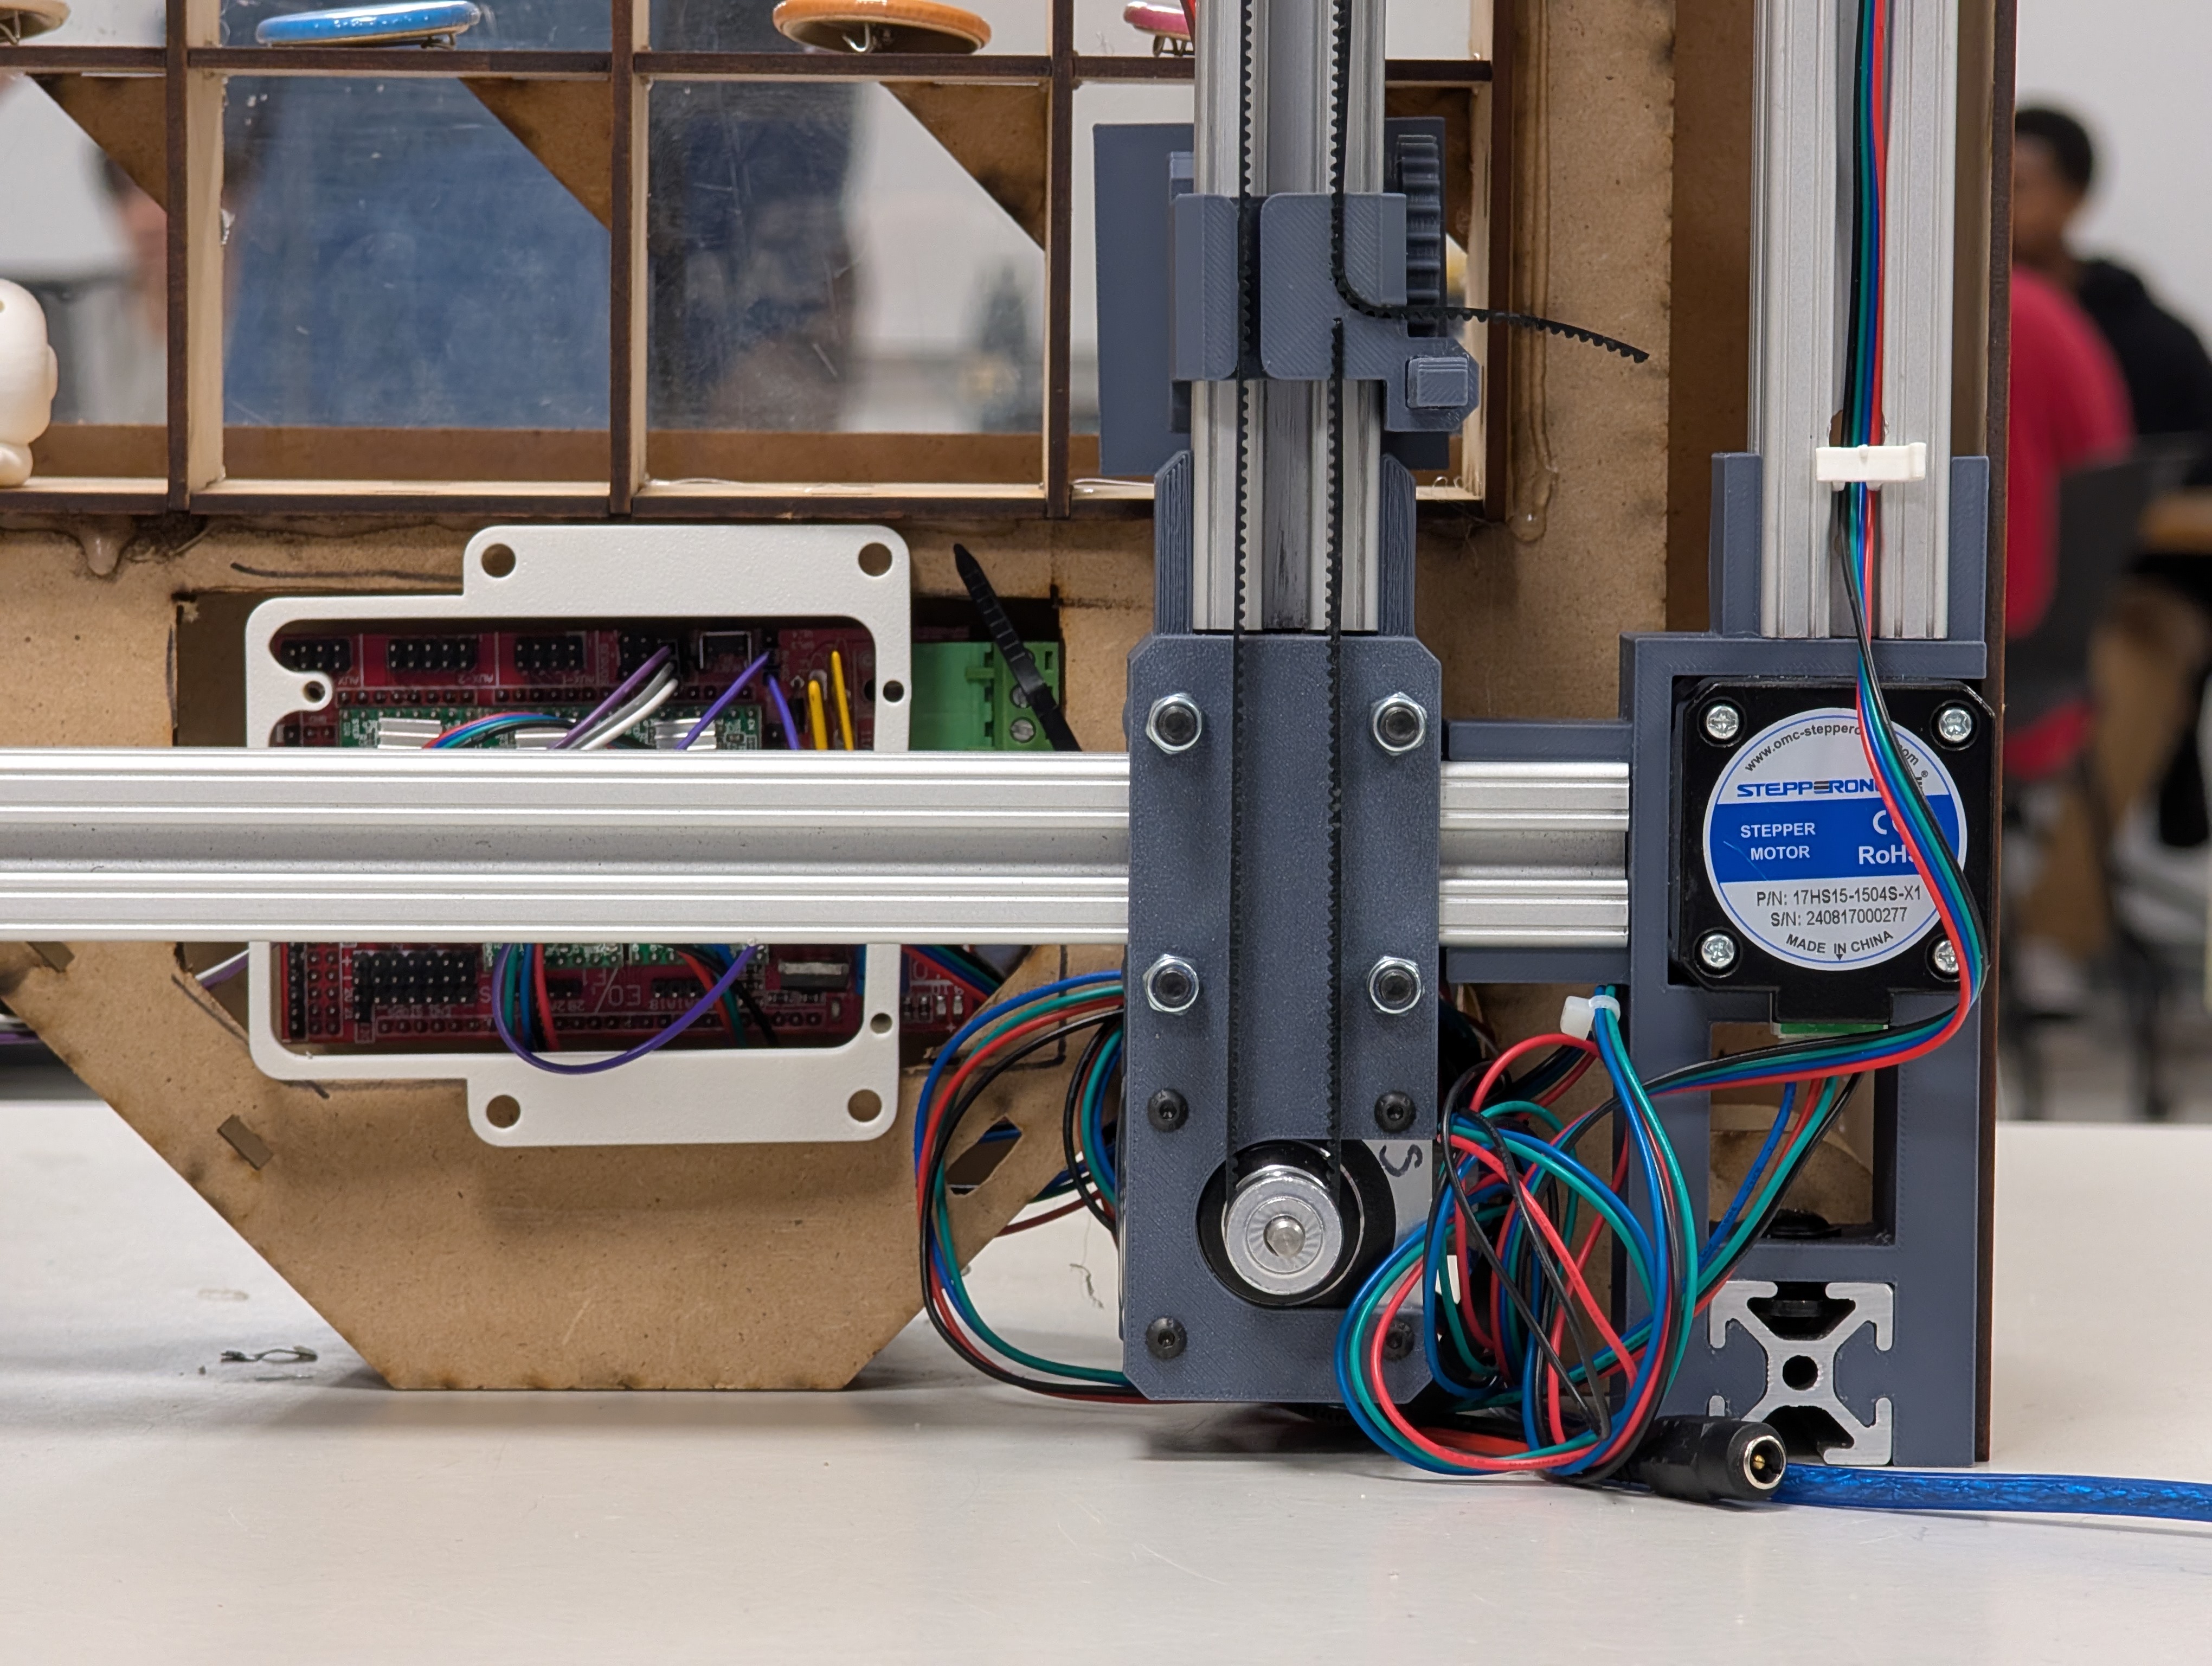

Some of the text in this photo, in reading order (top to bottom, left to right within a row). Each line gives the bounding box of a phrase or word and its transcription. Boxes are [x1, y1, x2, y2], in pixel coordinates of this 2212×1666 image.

[1740, 822, 1816, 838] STEPPER
[1751, 845, 1811, 861] MOTOR
[1859, 844, 1914, 864] RoH
[1757, 885, 1921, 906] P/N: 17HS15-1504S-X1
[1770, 907, 1908, 927] S/N: 240817000277
[1786, 930, 1894, 954] MADE IN CHINA
